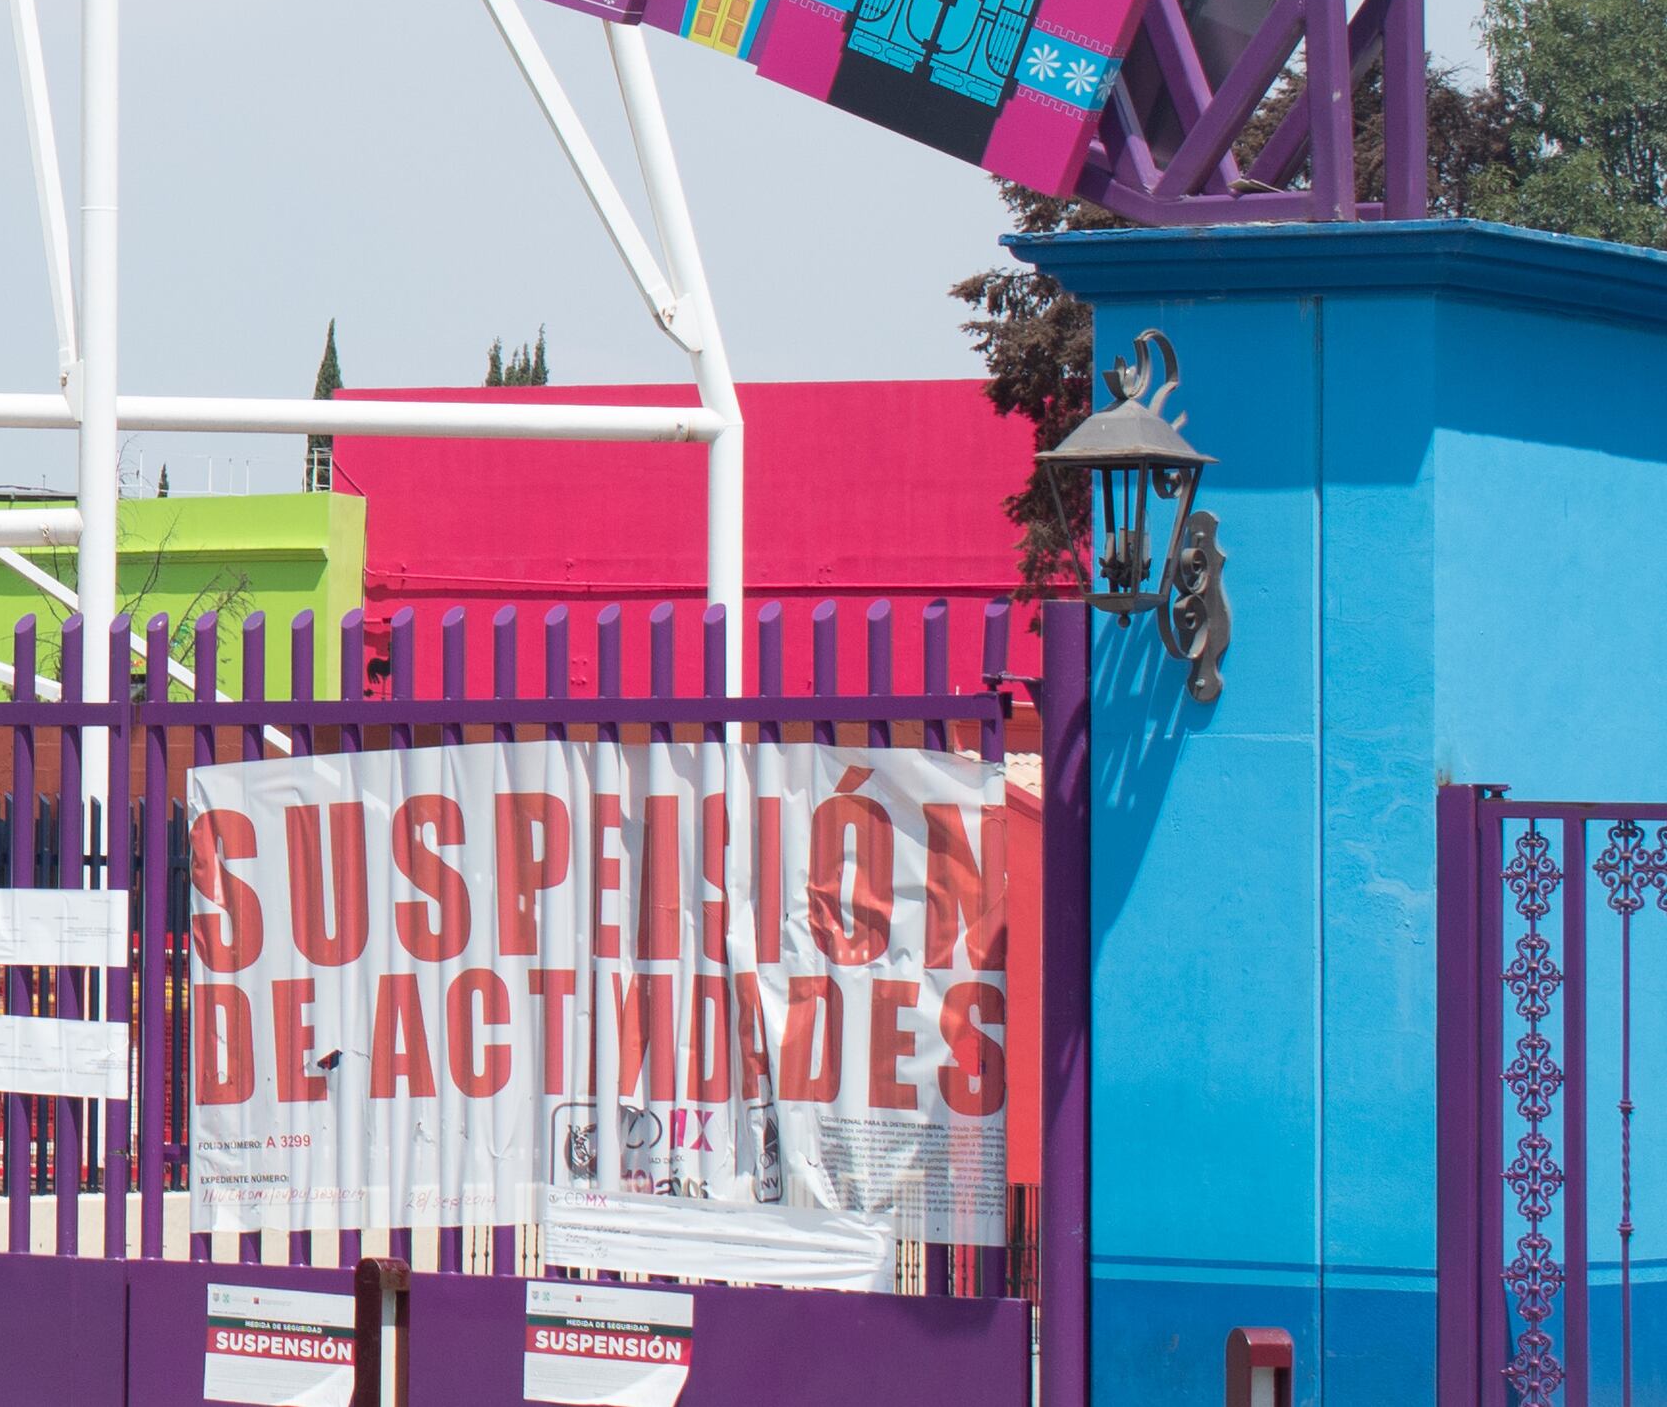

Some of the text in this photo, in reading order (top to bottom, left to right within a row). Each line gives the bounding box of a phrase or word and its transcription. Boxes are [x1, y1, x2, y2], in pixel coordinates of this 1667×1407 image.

[195, 978, 330, 1105] DE
[266, 1138, 275, 1149] A
[280, 1134, 311, 1148] 3299
[200, 1173, 289, 1184] EXPEDIENTE NÚMERO:
[564, 1192, 608, 1208] CDMX
[216, 1331, 352, 1361] SUSPENSIÓN
[535, 1329, 681, 1361] SUSPENSIÓN
